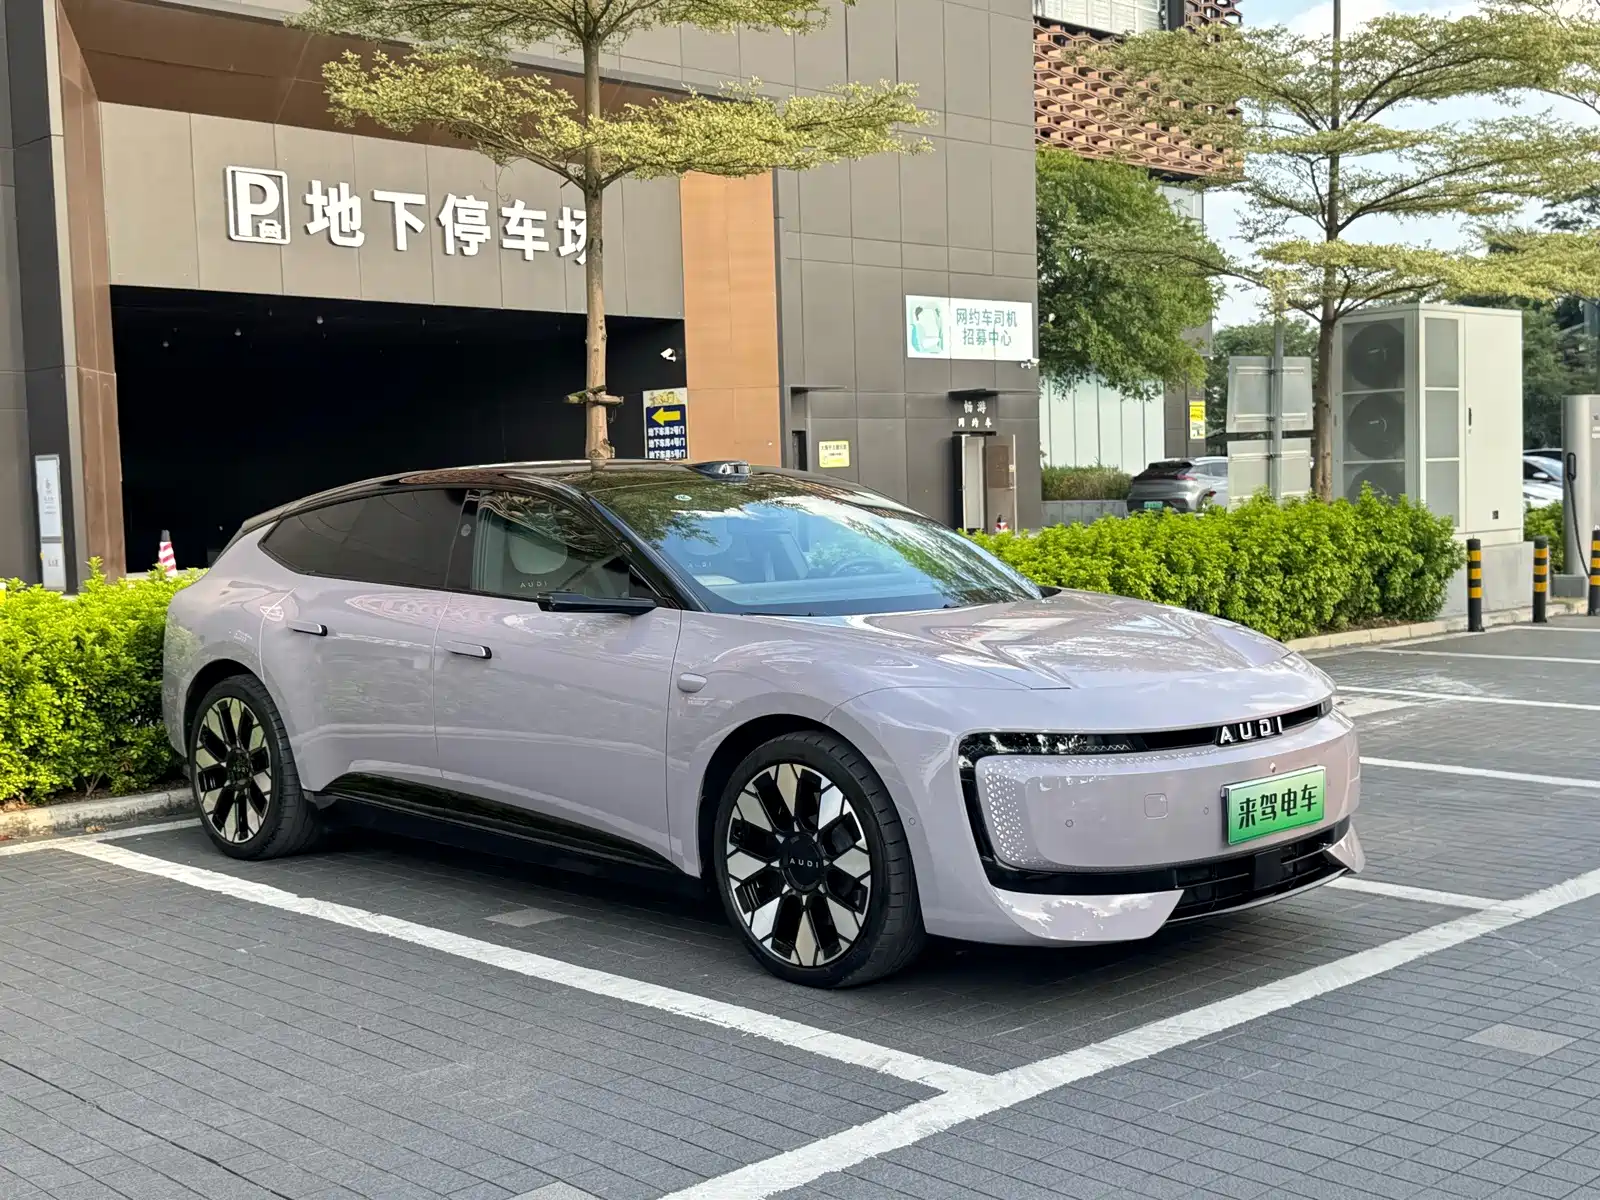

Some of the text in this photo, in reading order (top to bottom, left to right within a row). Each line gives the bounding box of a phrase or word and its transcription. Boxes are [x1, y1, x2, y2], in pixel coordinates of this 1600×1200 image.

[304, 179, 587, 266] 地下停车场
[956, 308, 1018, 327] 网约车司机
[962, 327, 1012, 346] 招募中心
[520, 580, 548, 588] AUDI
[1219, 716, 1283, 744] AUDI
[1238, 783, 1318, 830] 来驾电车
[790, 857, 819, 869] AUDI
